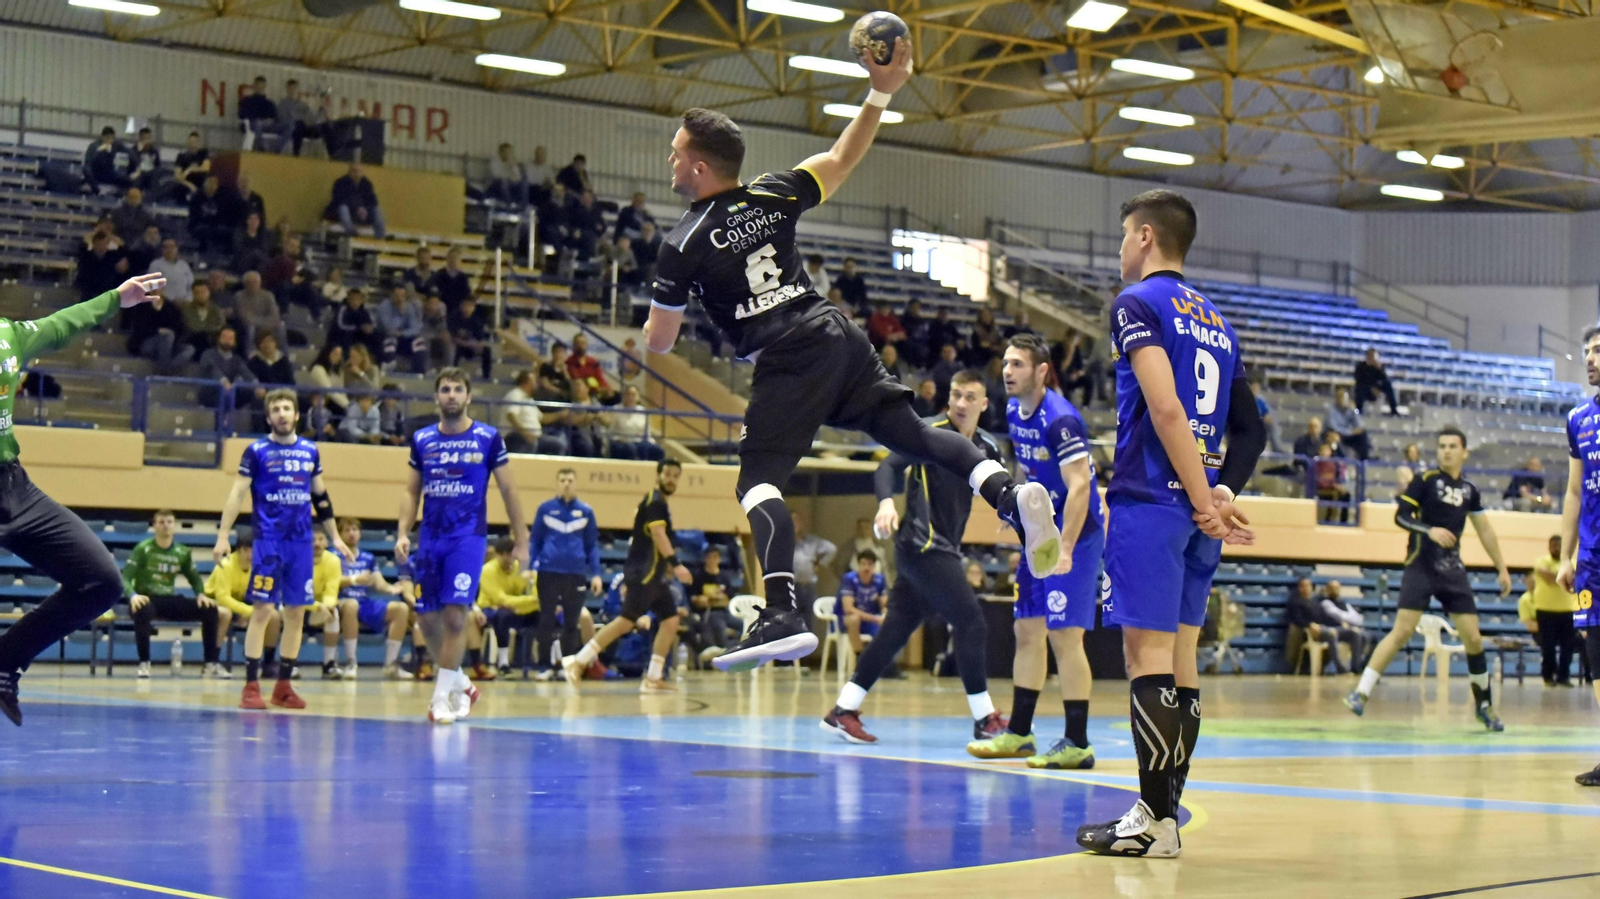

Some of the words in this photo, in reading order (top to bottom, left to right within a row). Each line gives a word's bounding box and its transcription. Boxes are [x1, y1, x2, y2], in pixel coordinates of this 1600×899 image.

[726, 207, 764, 227] GRUPO
[731, 225, 778, 254] DENTAL
[745, 243, 783, 295] 6
[1194, 347, 1220, 415] 9
[279, 449, 312, 459] TOYOTA
[440, 440, 479, 450] TOYOTA
[1020, 443, 1032, 460] 35
[284, 459, 301, 472] 53
[440, 451, 459, 464] 94
[1442, 485, 1464, 507] 25
[253, 574, 274, 592] 53
